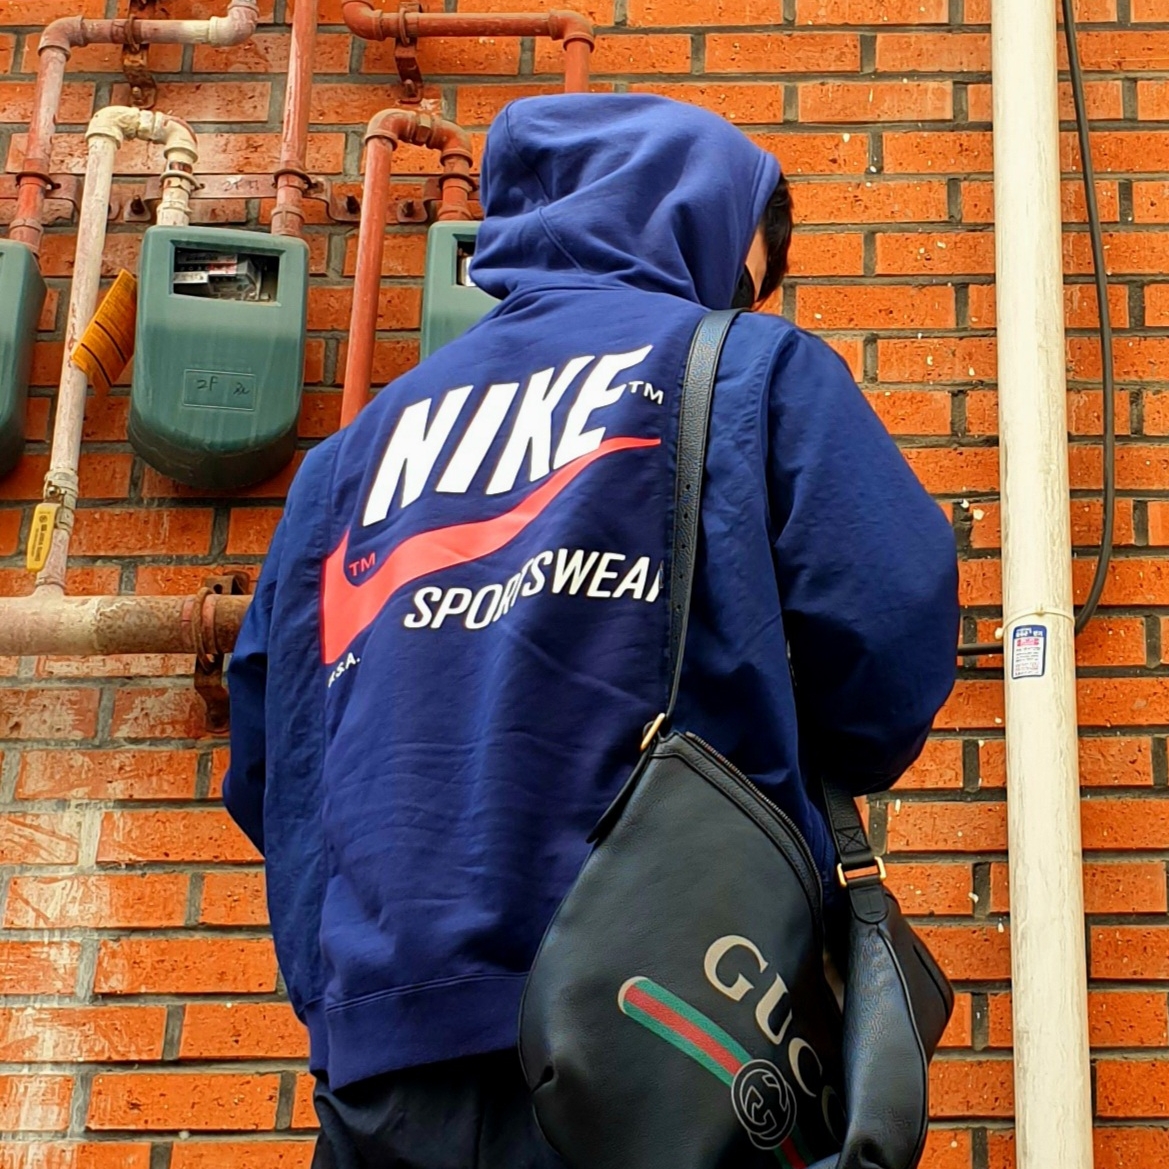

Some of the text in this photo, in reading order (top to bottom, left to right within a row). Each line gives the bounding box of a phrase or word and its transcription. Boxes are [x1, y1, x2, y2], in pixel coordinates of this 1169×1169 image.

[362, 345, 664, 527] NIKE TM
[348, 551, 377, 577] TM
[703, 934, 849, 1147] GUCC
